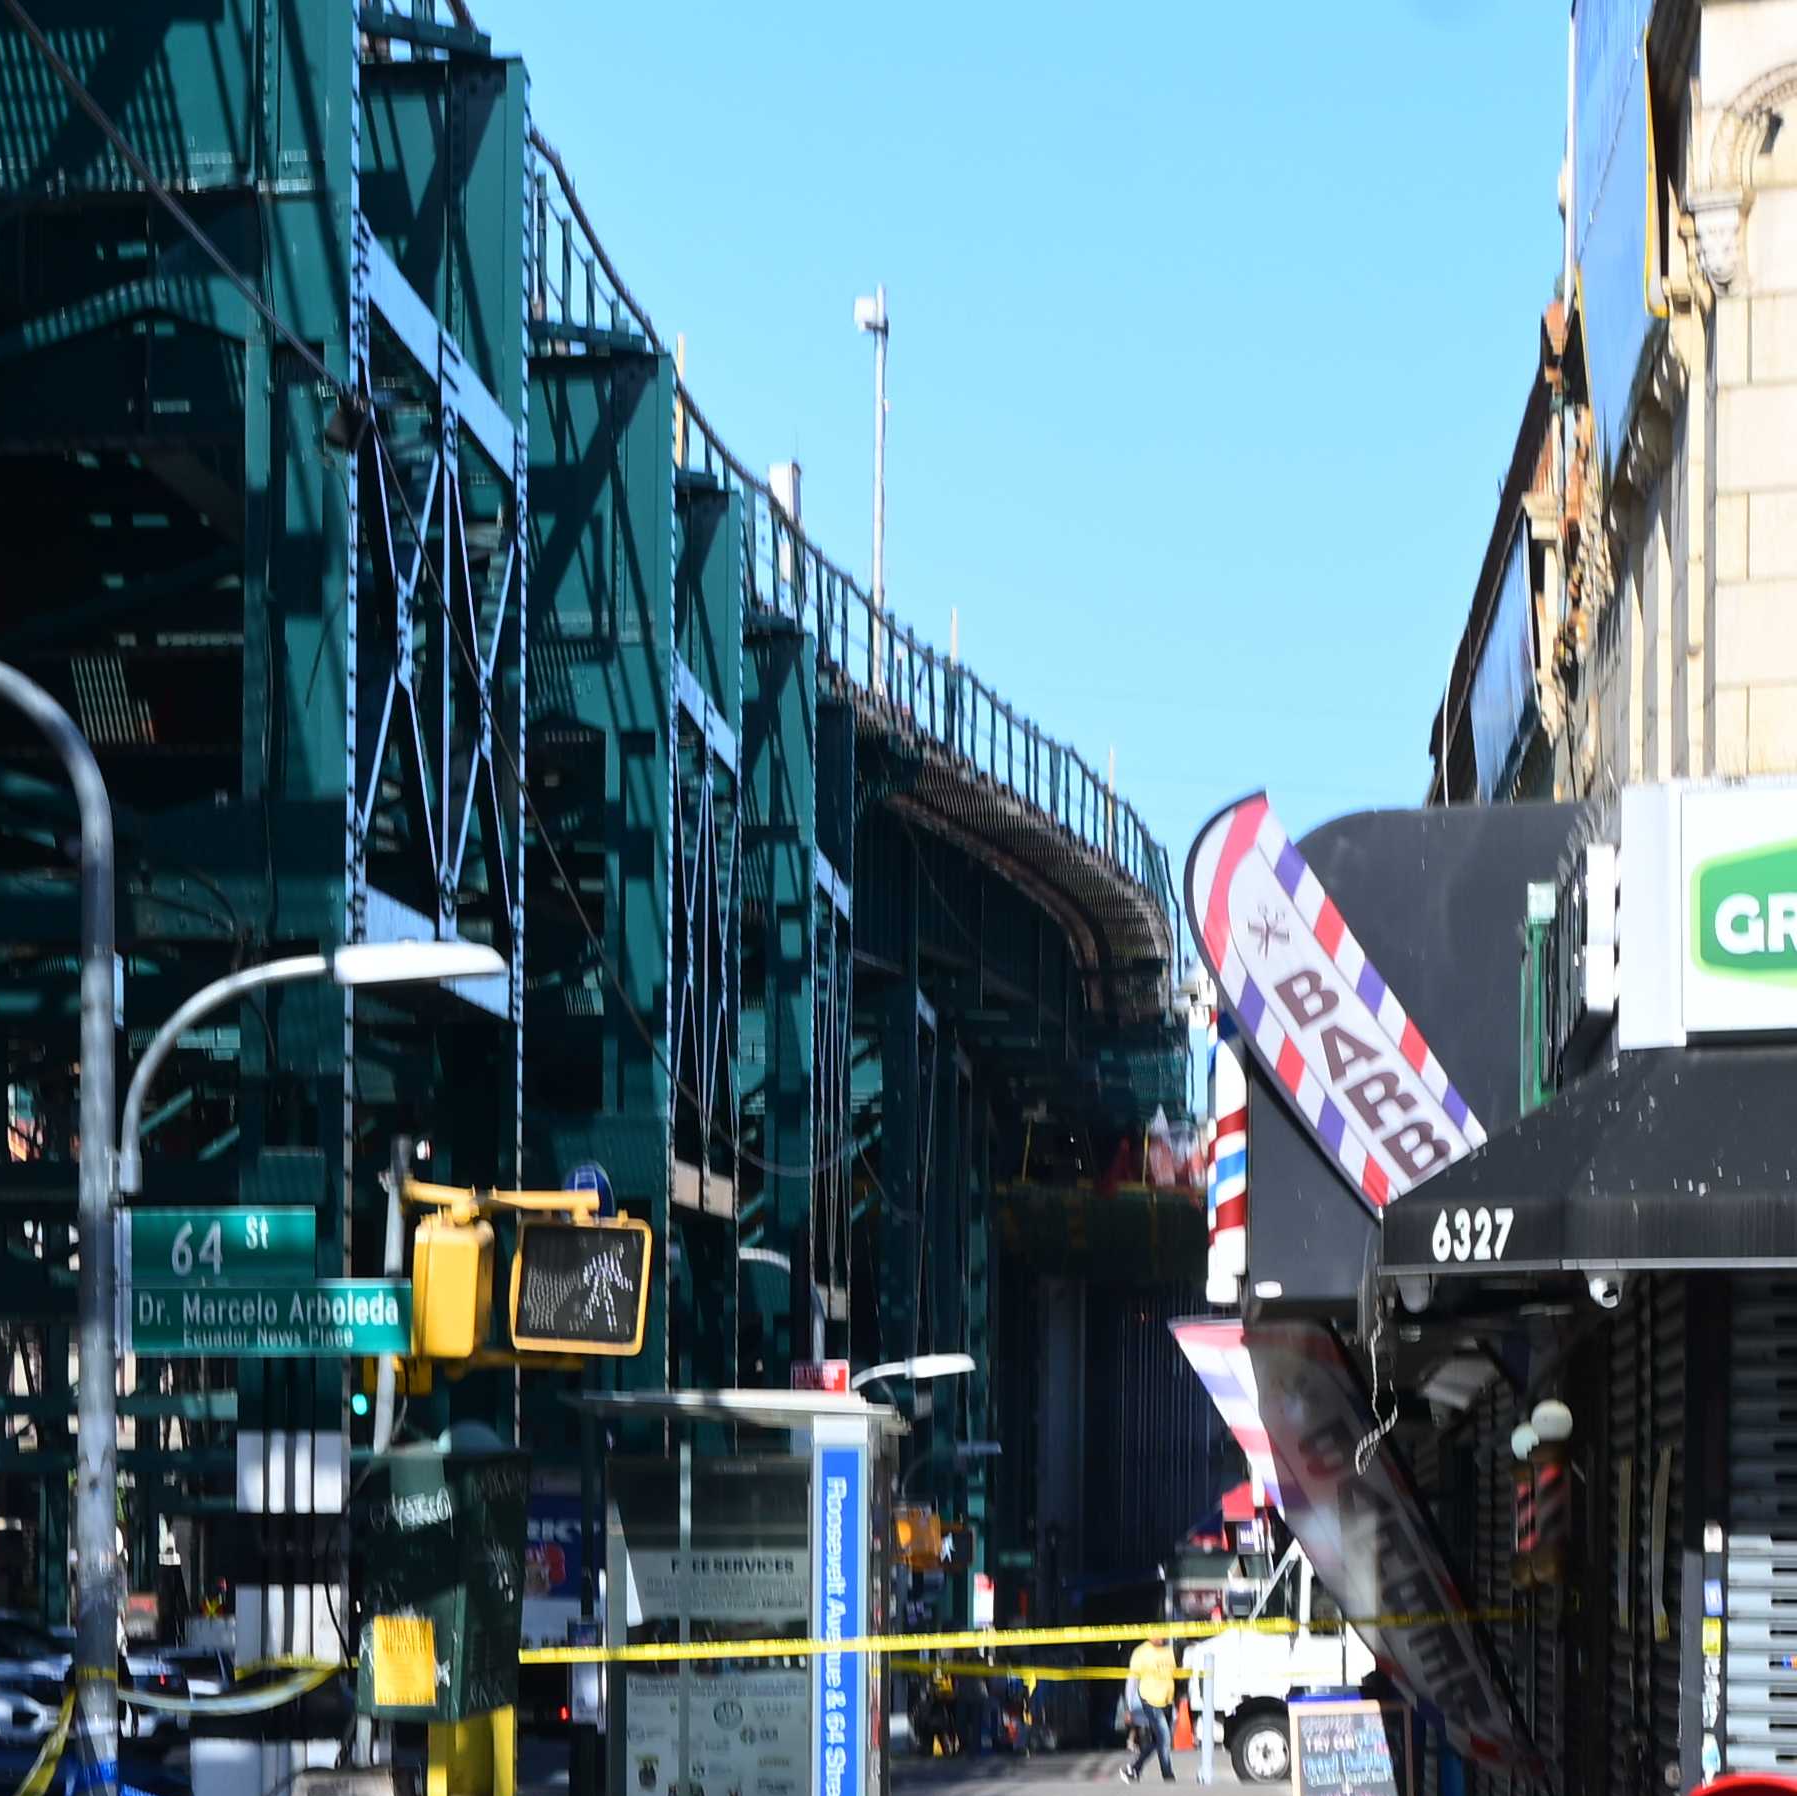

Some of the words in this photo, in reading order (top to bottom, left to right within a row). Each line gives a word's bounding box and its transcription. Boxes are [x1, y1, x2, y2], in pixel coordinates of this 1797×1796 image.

[1714, 890, 1797, 956] GR
[1273, 968, 1452, 1182] BARB
[171, 1220, 223, 1277] 64
[244, 1214, 269, 1250] St
[1431, 1207, 1514, 1262] 6327
[138, 1290, 172, 1327] Dr.
[182, 1290, 278, 1327] Marcelo
[289, 1289, 399, 1327] Arboleda
[256, 1327, 302, 1350] News
[308, 1326, 354, 1349] Place
[825, 1476, 849, 1596] Roosevelt
[670, 1556, 710, 1575] FEE
[825, 1690, 849, 1709] &
[825, 1712, 849, 1744] 64
